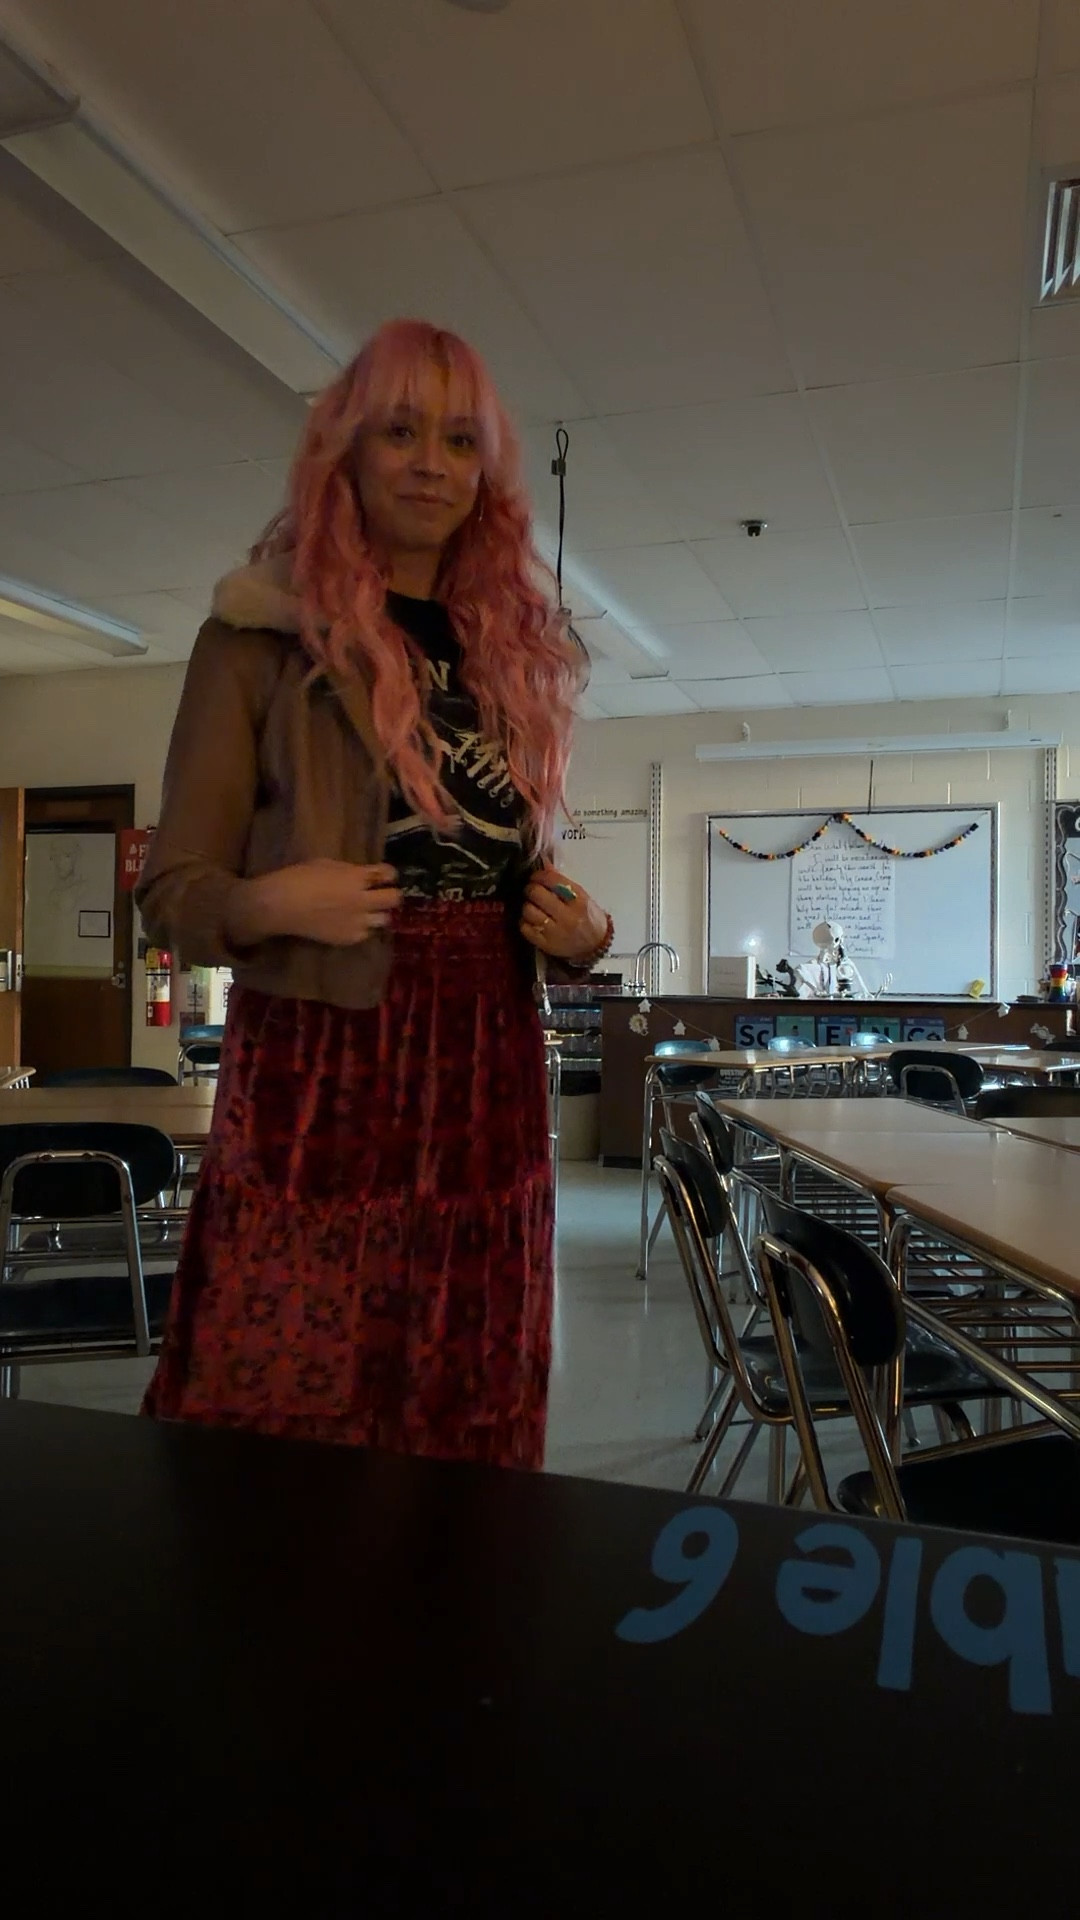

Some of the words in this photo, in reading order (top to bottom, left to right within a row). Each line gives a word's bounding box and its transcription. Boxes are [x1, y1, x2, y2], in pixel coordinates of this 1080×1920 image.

[583, 808, 617, 818] something
[621, 809, 647, 817] amazing
[775, 1522, 1080, 1716] ble
